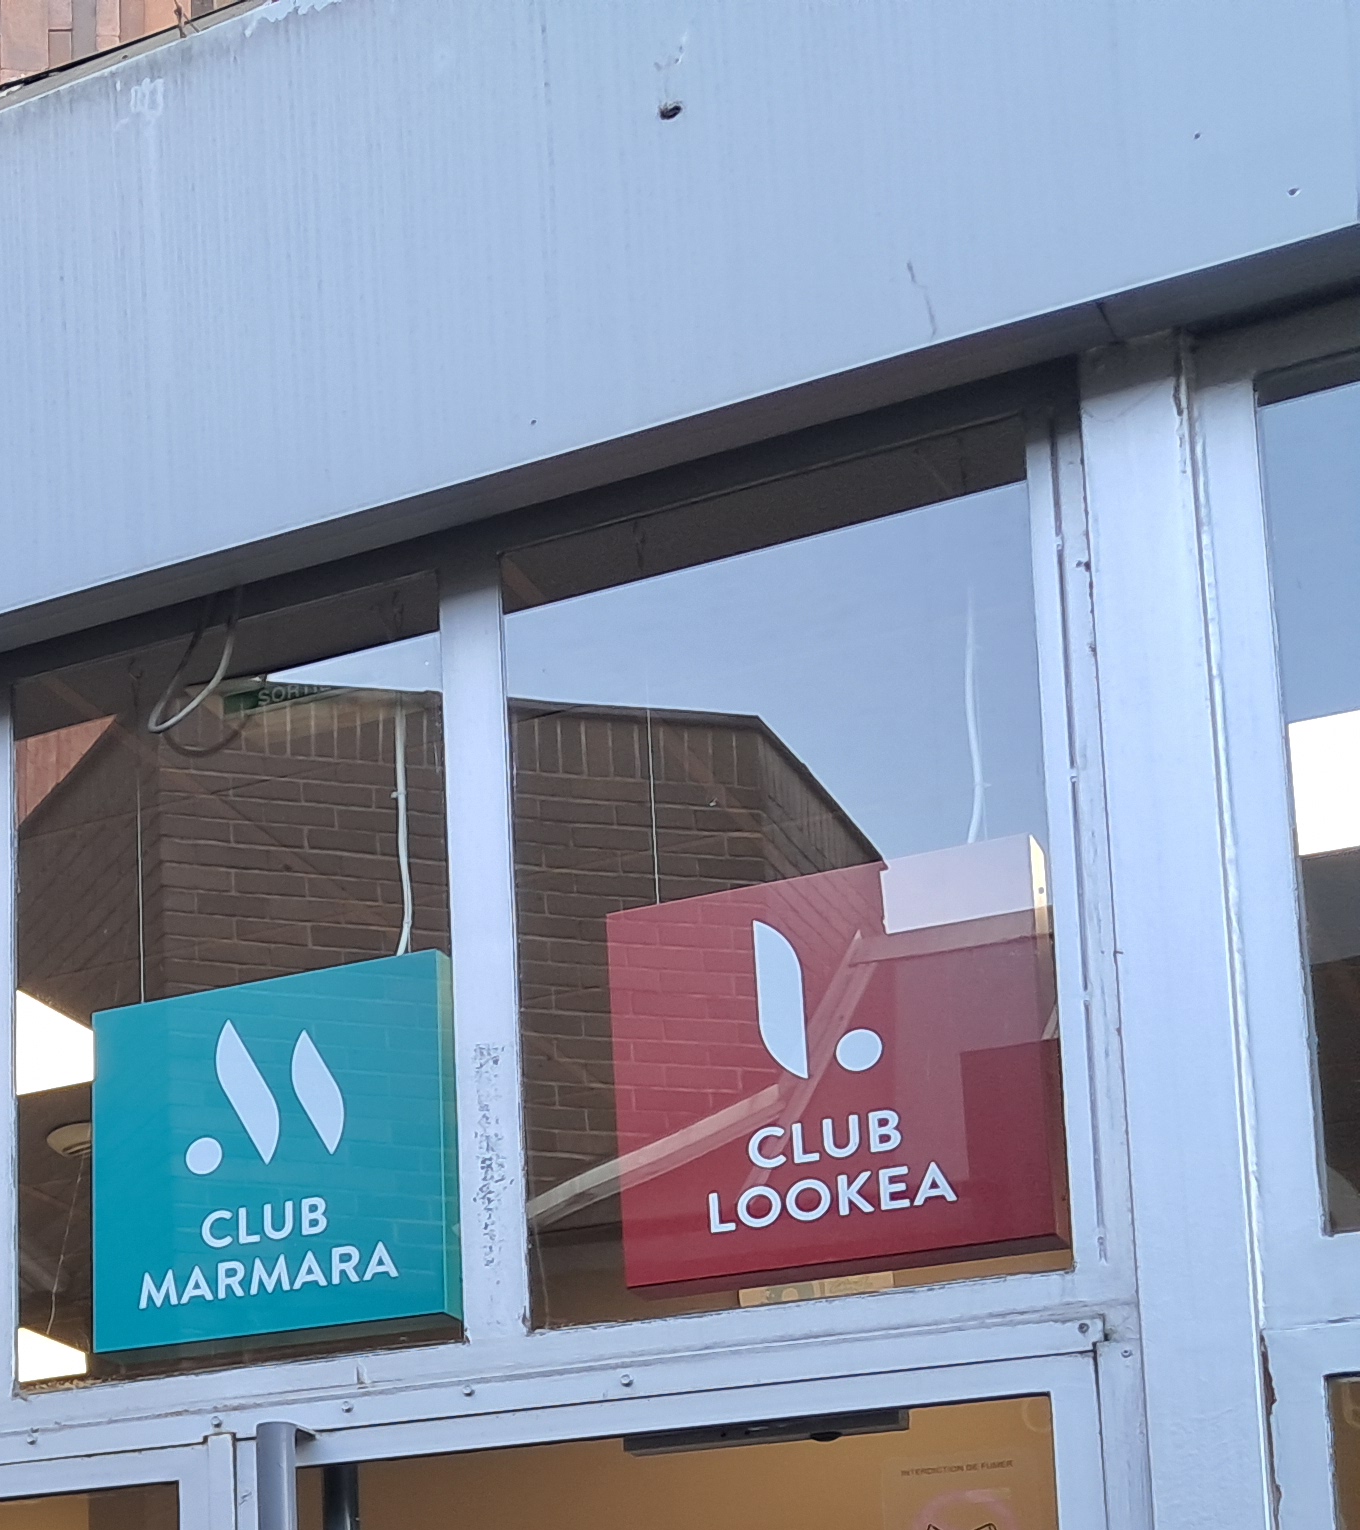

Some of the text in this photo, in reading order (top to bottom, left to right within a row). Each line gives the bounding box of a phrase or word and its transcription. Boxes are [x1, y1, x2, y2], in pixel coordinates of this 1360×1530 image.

[748, 1109, 902, 1168] CLUB
[201, 1196, 328, 1248] CLUB
[708, 1160, 957, 1234] LOOKEA
[138, 1240, 399, 1310] MARMARA
